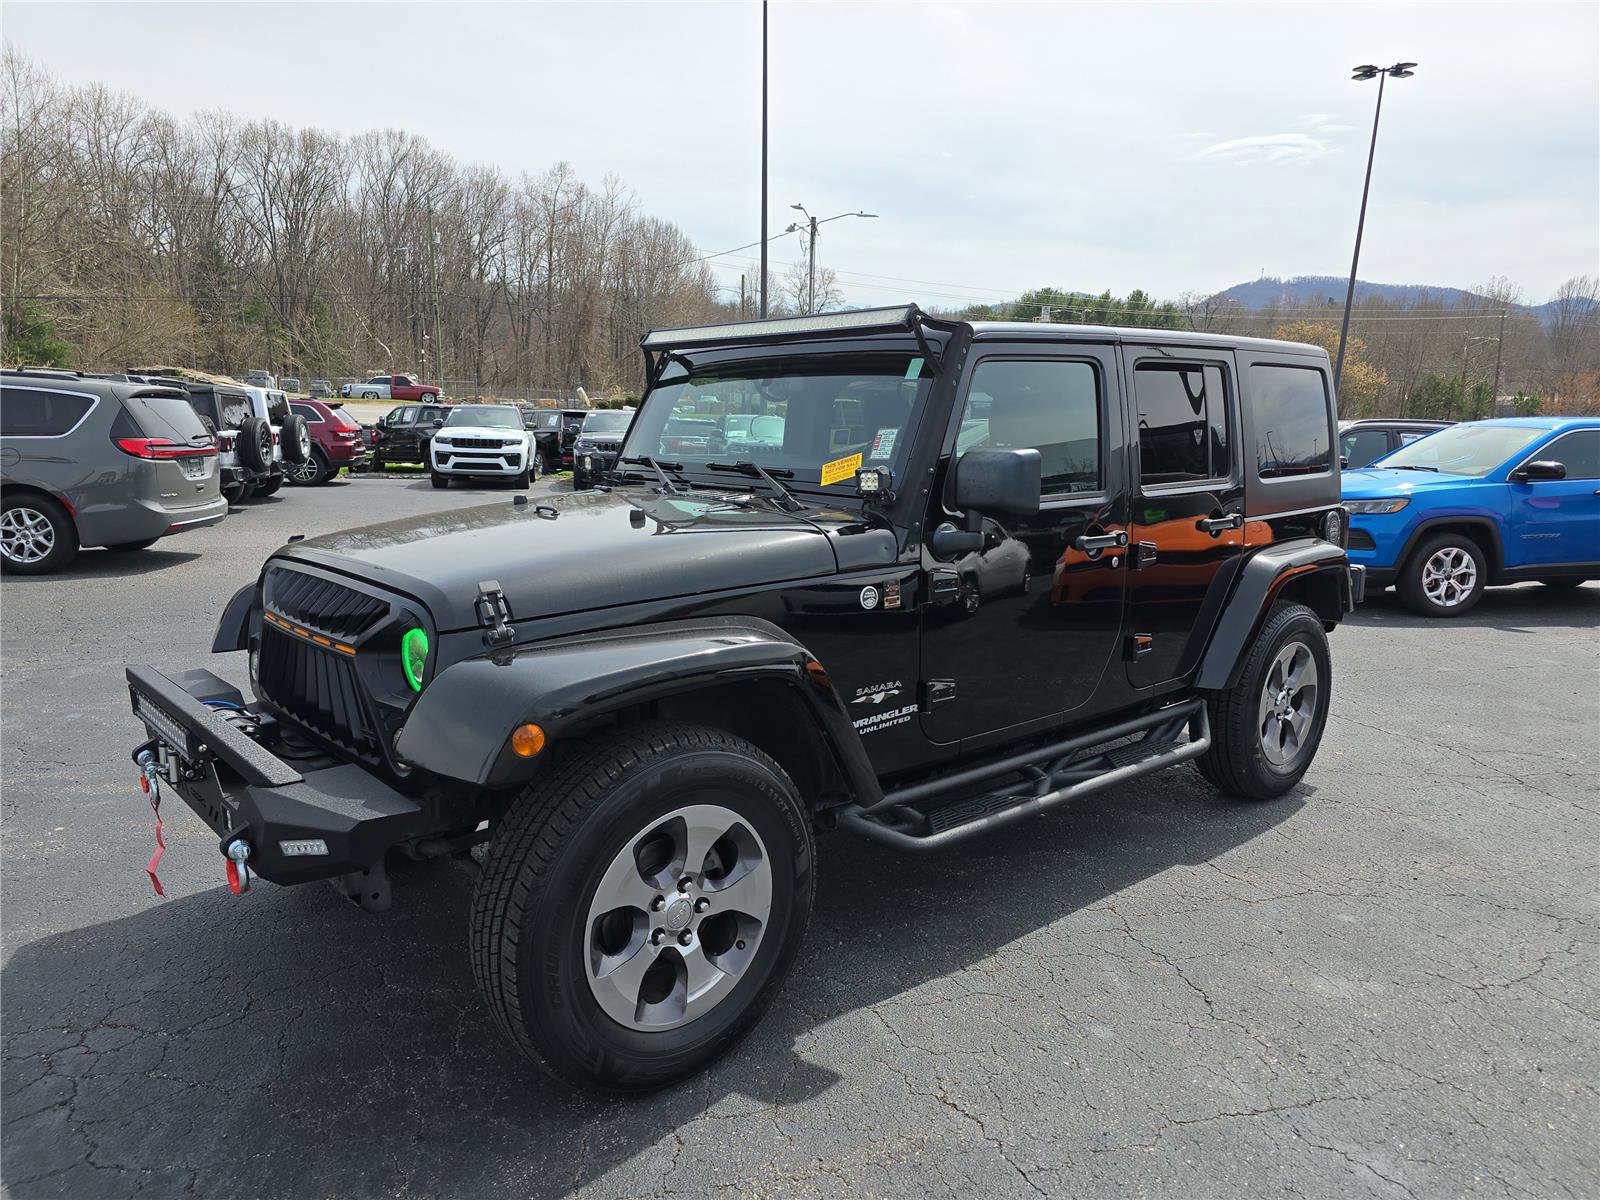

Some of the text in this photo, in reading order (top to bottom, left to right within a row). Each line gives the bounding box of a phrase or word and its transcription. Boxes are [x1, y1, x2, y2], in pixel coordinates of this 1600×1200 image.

[824, 454, 861, 470] THIS VEHICLE
[825, 467, 835, 475] NOT
[835, 464, 844, 473] FOR
[845, 460, 859, 470] SALE
[856, 680, 902, 696] SAHARA
[859, 715, 911, 735] UNLIMITED
